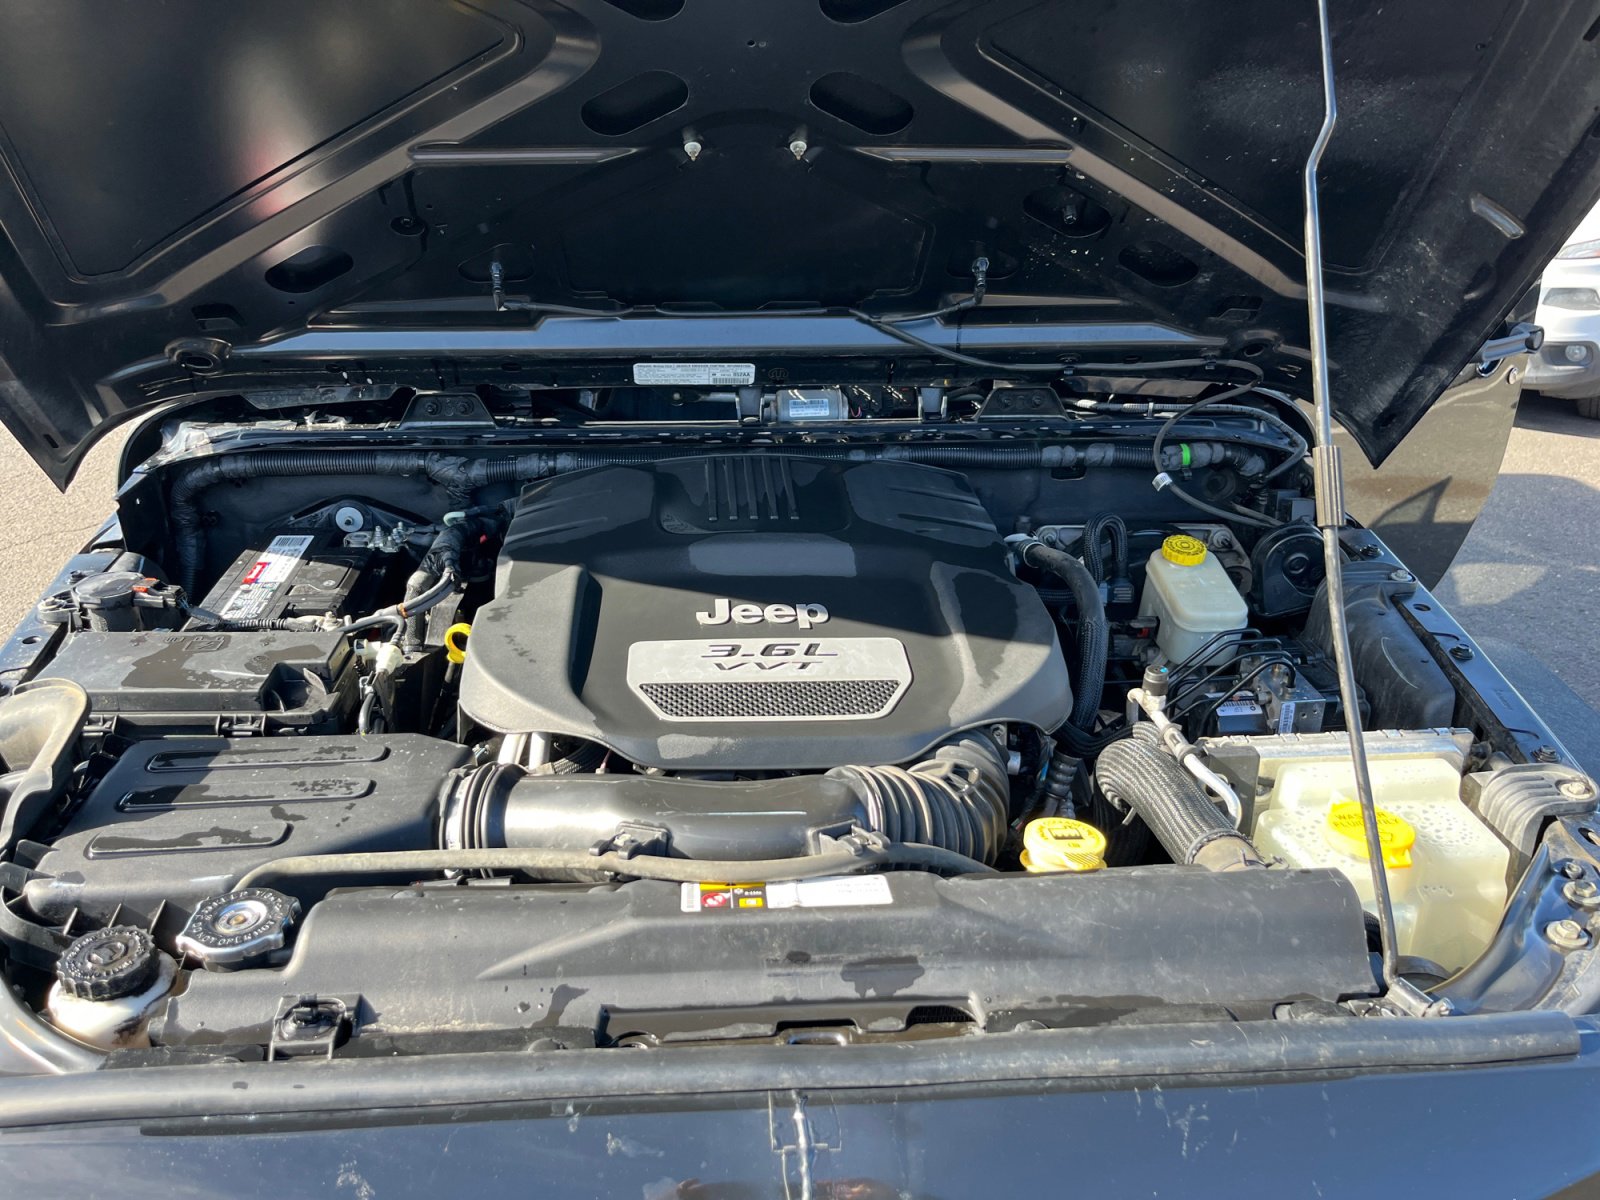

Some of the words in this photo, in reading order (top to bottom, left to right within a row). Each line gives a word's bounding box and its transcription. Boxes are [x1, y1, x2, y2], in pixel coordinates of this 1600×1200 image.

[695, 598, 830, 629] Jeep
[701, 643, 838, 657] 3.6L
[713, 661, 823, 671] VVT
[1334, 811, 1387, 821] WASER
[196, 931, 217, 944] NOT
